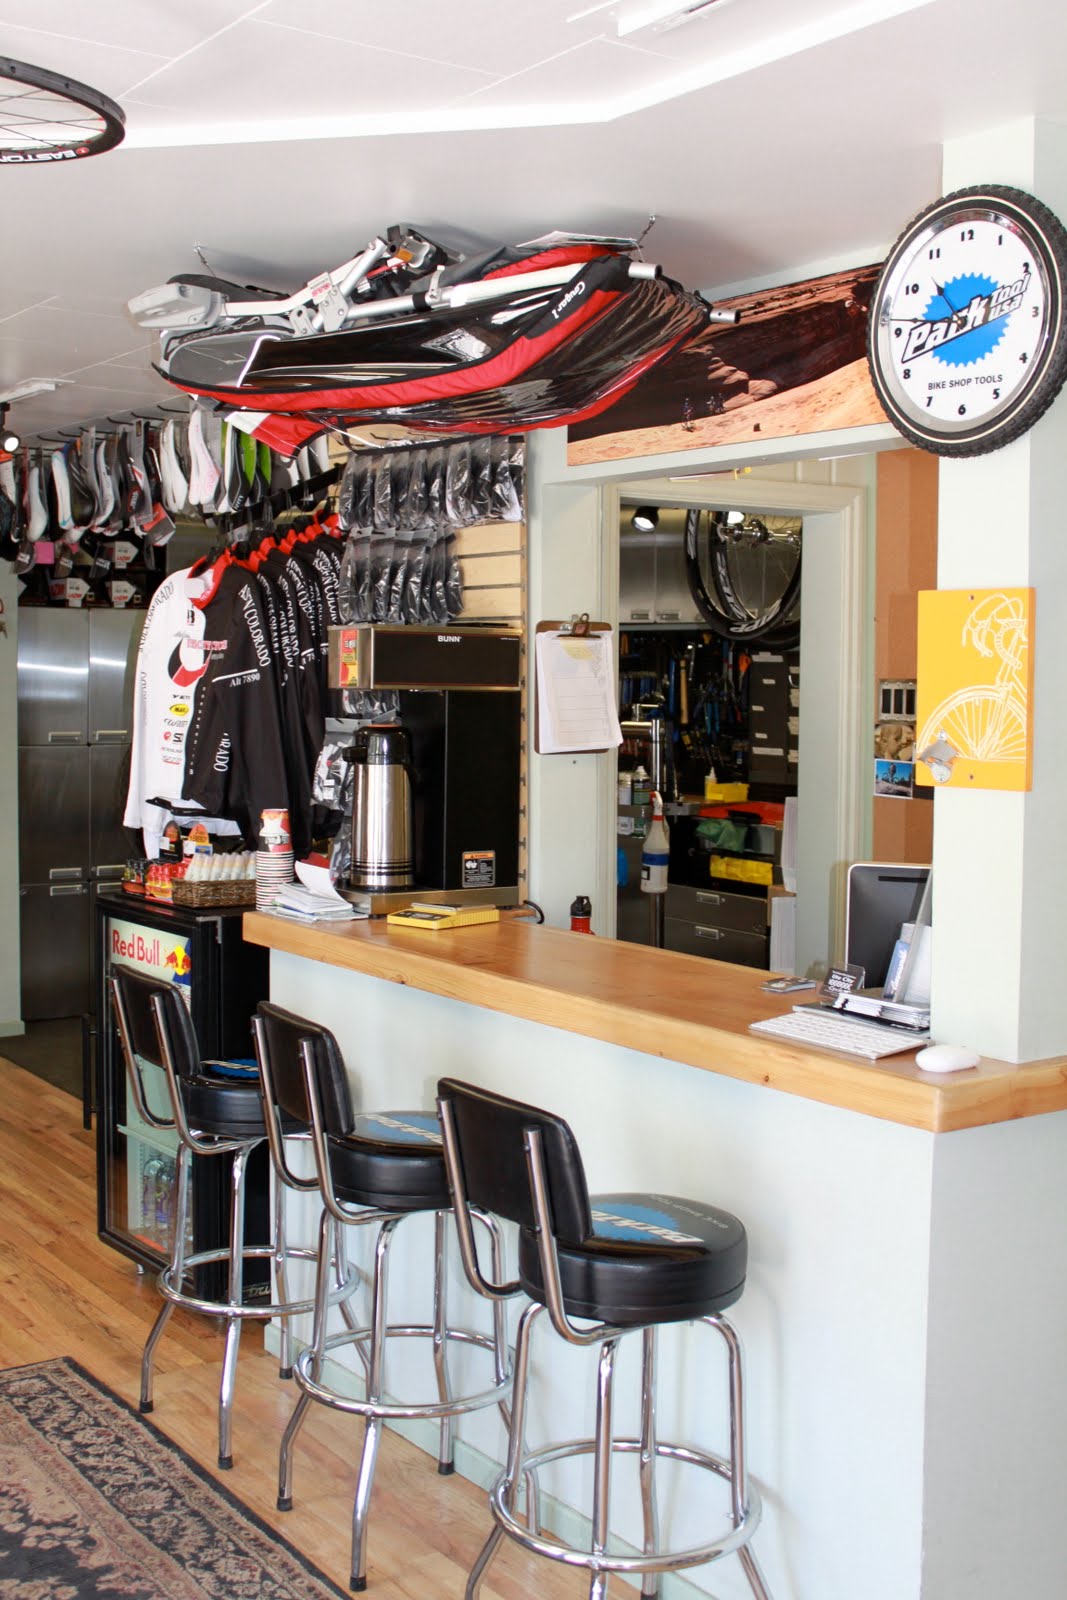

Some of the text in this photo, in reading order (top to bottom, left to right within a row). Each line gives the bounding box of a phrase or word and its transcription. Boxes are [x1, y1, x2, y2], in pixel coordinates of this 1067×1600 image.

[960, 229, 975, 242] 12
[998, 234, 1003, 246] 1
[928, 248, 941, 260] 11
[1022, 262, 1031, 274] 2
[905, 283, 920, 295] 10
[989, 272, 1032, 308] Tool
[1031, 306, 1040, 318] 3
[894, 326, 902, 339] 9
[901, 293, 992, 364] Park
[1019, 352, 1028, 364] 4
[903, 369, 911, 380] 8
[928, 374, 1003, 391] BIKE SHOP TOOLS
[992, 388, 1000, 400] 5
[926, 396, 933, 408] 7
[958, 404, 967, 416] 6
[243, 608, 272, 668] COLORADO
[213, 732, 231, 772] RADO
[112, 929, 160, 967] Red Bull
